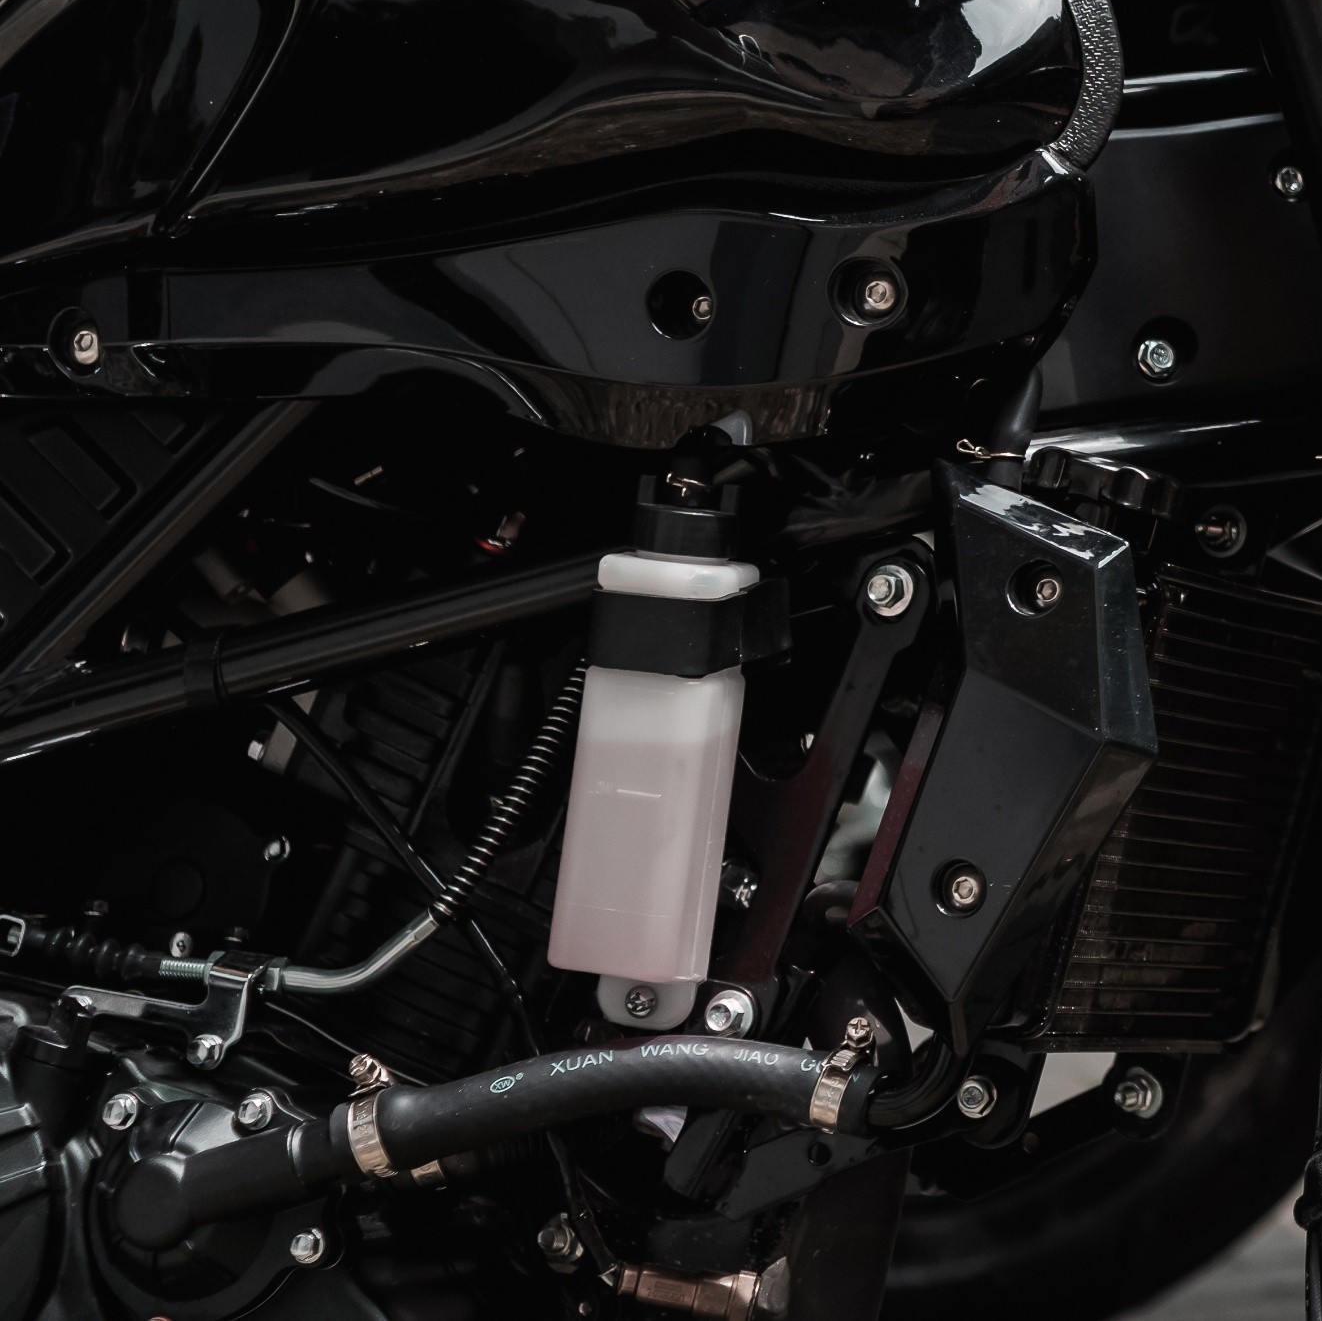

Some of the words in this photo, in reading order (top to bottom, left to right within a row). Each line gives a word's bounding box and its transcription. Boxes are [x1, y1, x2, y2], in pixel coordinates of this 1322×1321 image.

[550, 1050, 614, 1076] XUAN
[640, 1043, 709, 1058] WANG
[733, 1048, 780, 1066] JIAO
